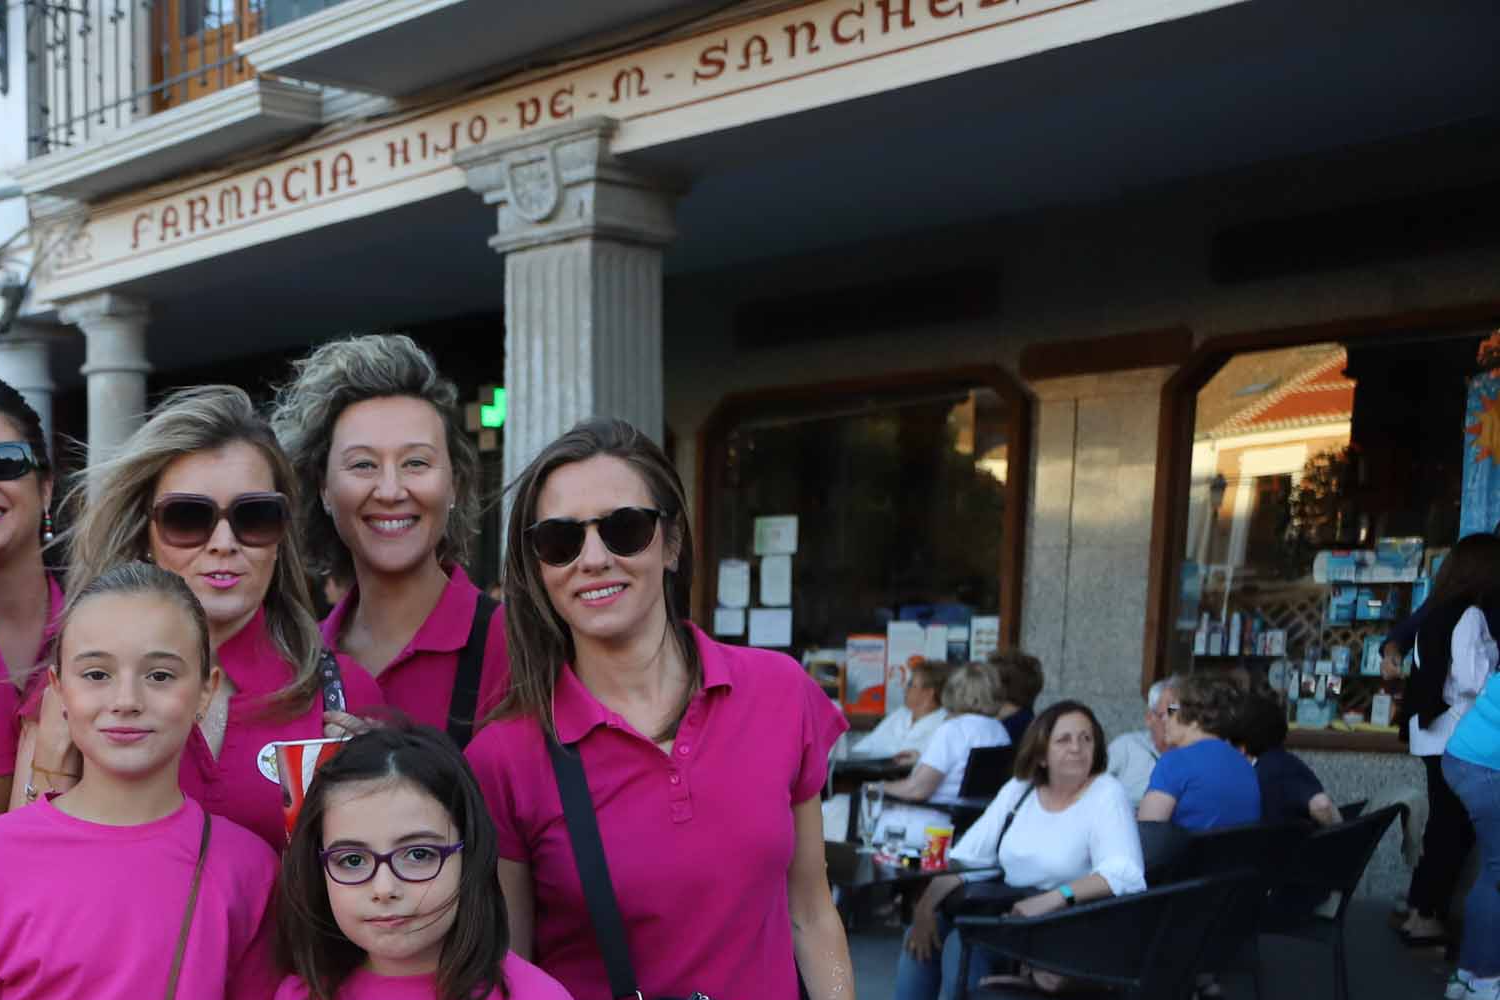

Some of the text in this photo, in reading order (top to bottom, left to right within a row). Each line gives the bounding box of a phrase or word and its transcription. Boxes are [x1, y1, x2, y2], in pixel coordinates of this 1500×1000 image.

[131, 0, 1020, 249] FARMACIA HIJO DE M SANCHE
